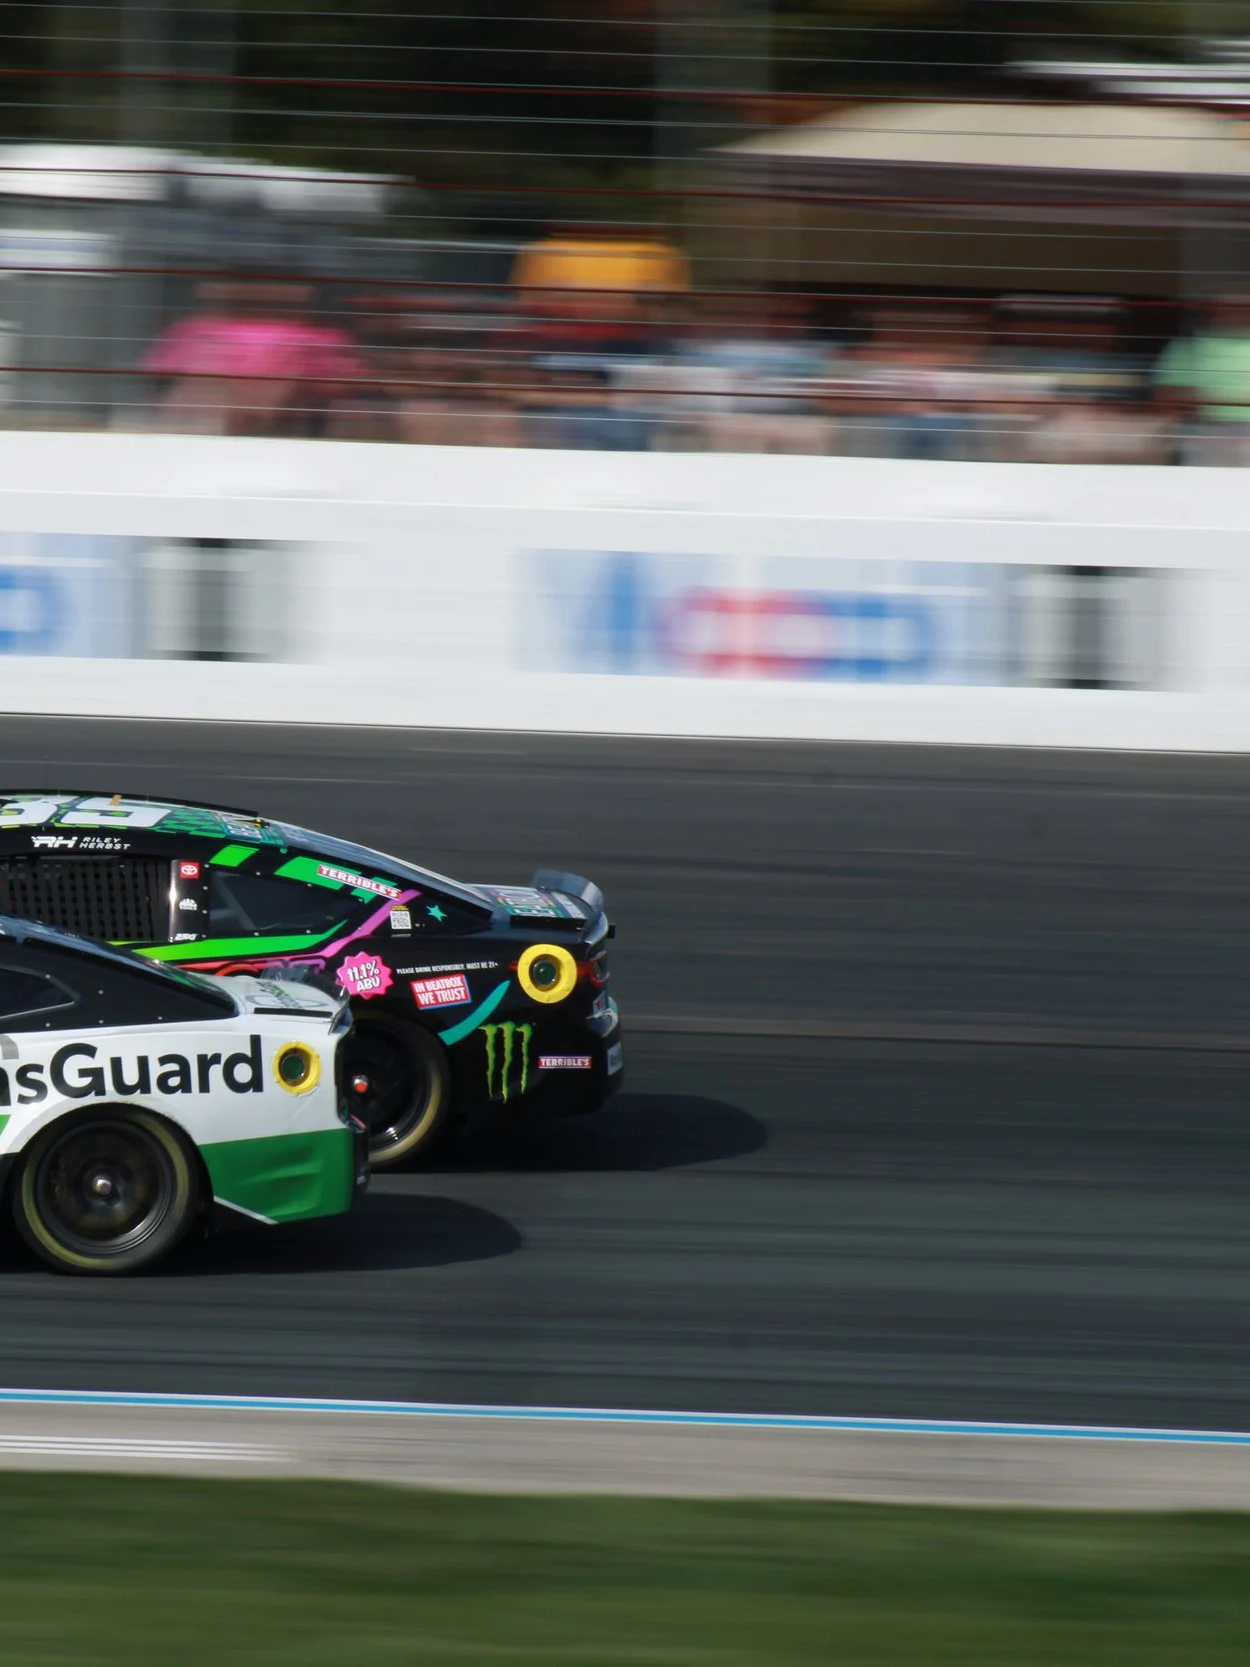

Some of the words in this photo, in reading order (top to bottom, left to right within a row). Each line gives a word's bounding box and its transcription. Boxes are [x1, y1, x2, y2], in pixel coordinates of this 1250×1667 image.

[320, 866, 400, 898] TERRIBLE'S
[347, 960, 380, 982] 11.1%
[414, 983, 426, 993] IN
[426, 976, 463, 991] BEATBOX
[417, 992, 436, 1005] WE
[437, 988, 466, 1002] TRUST
[540, 1058, 590, 1066] TERRIBLE'S
